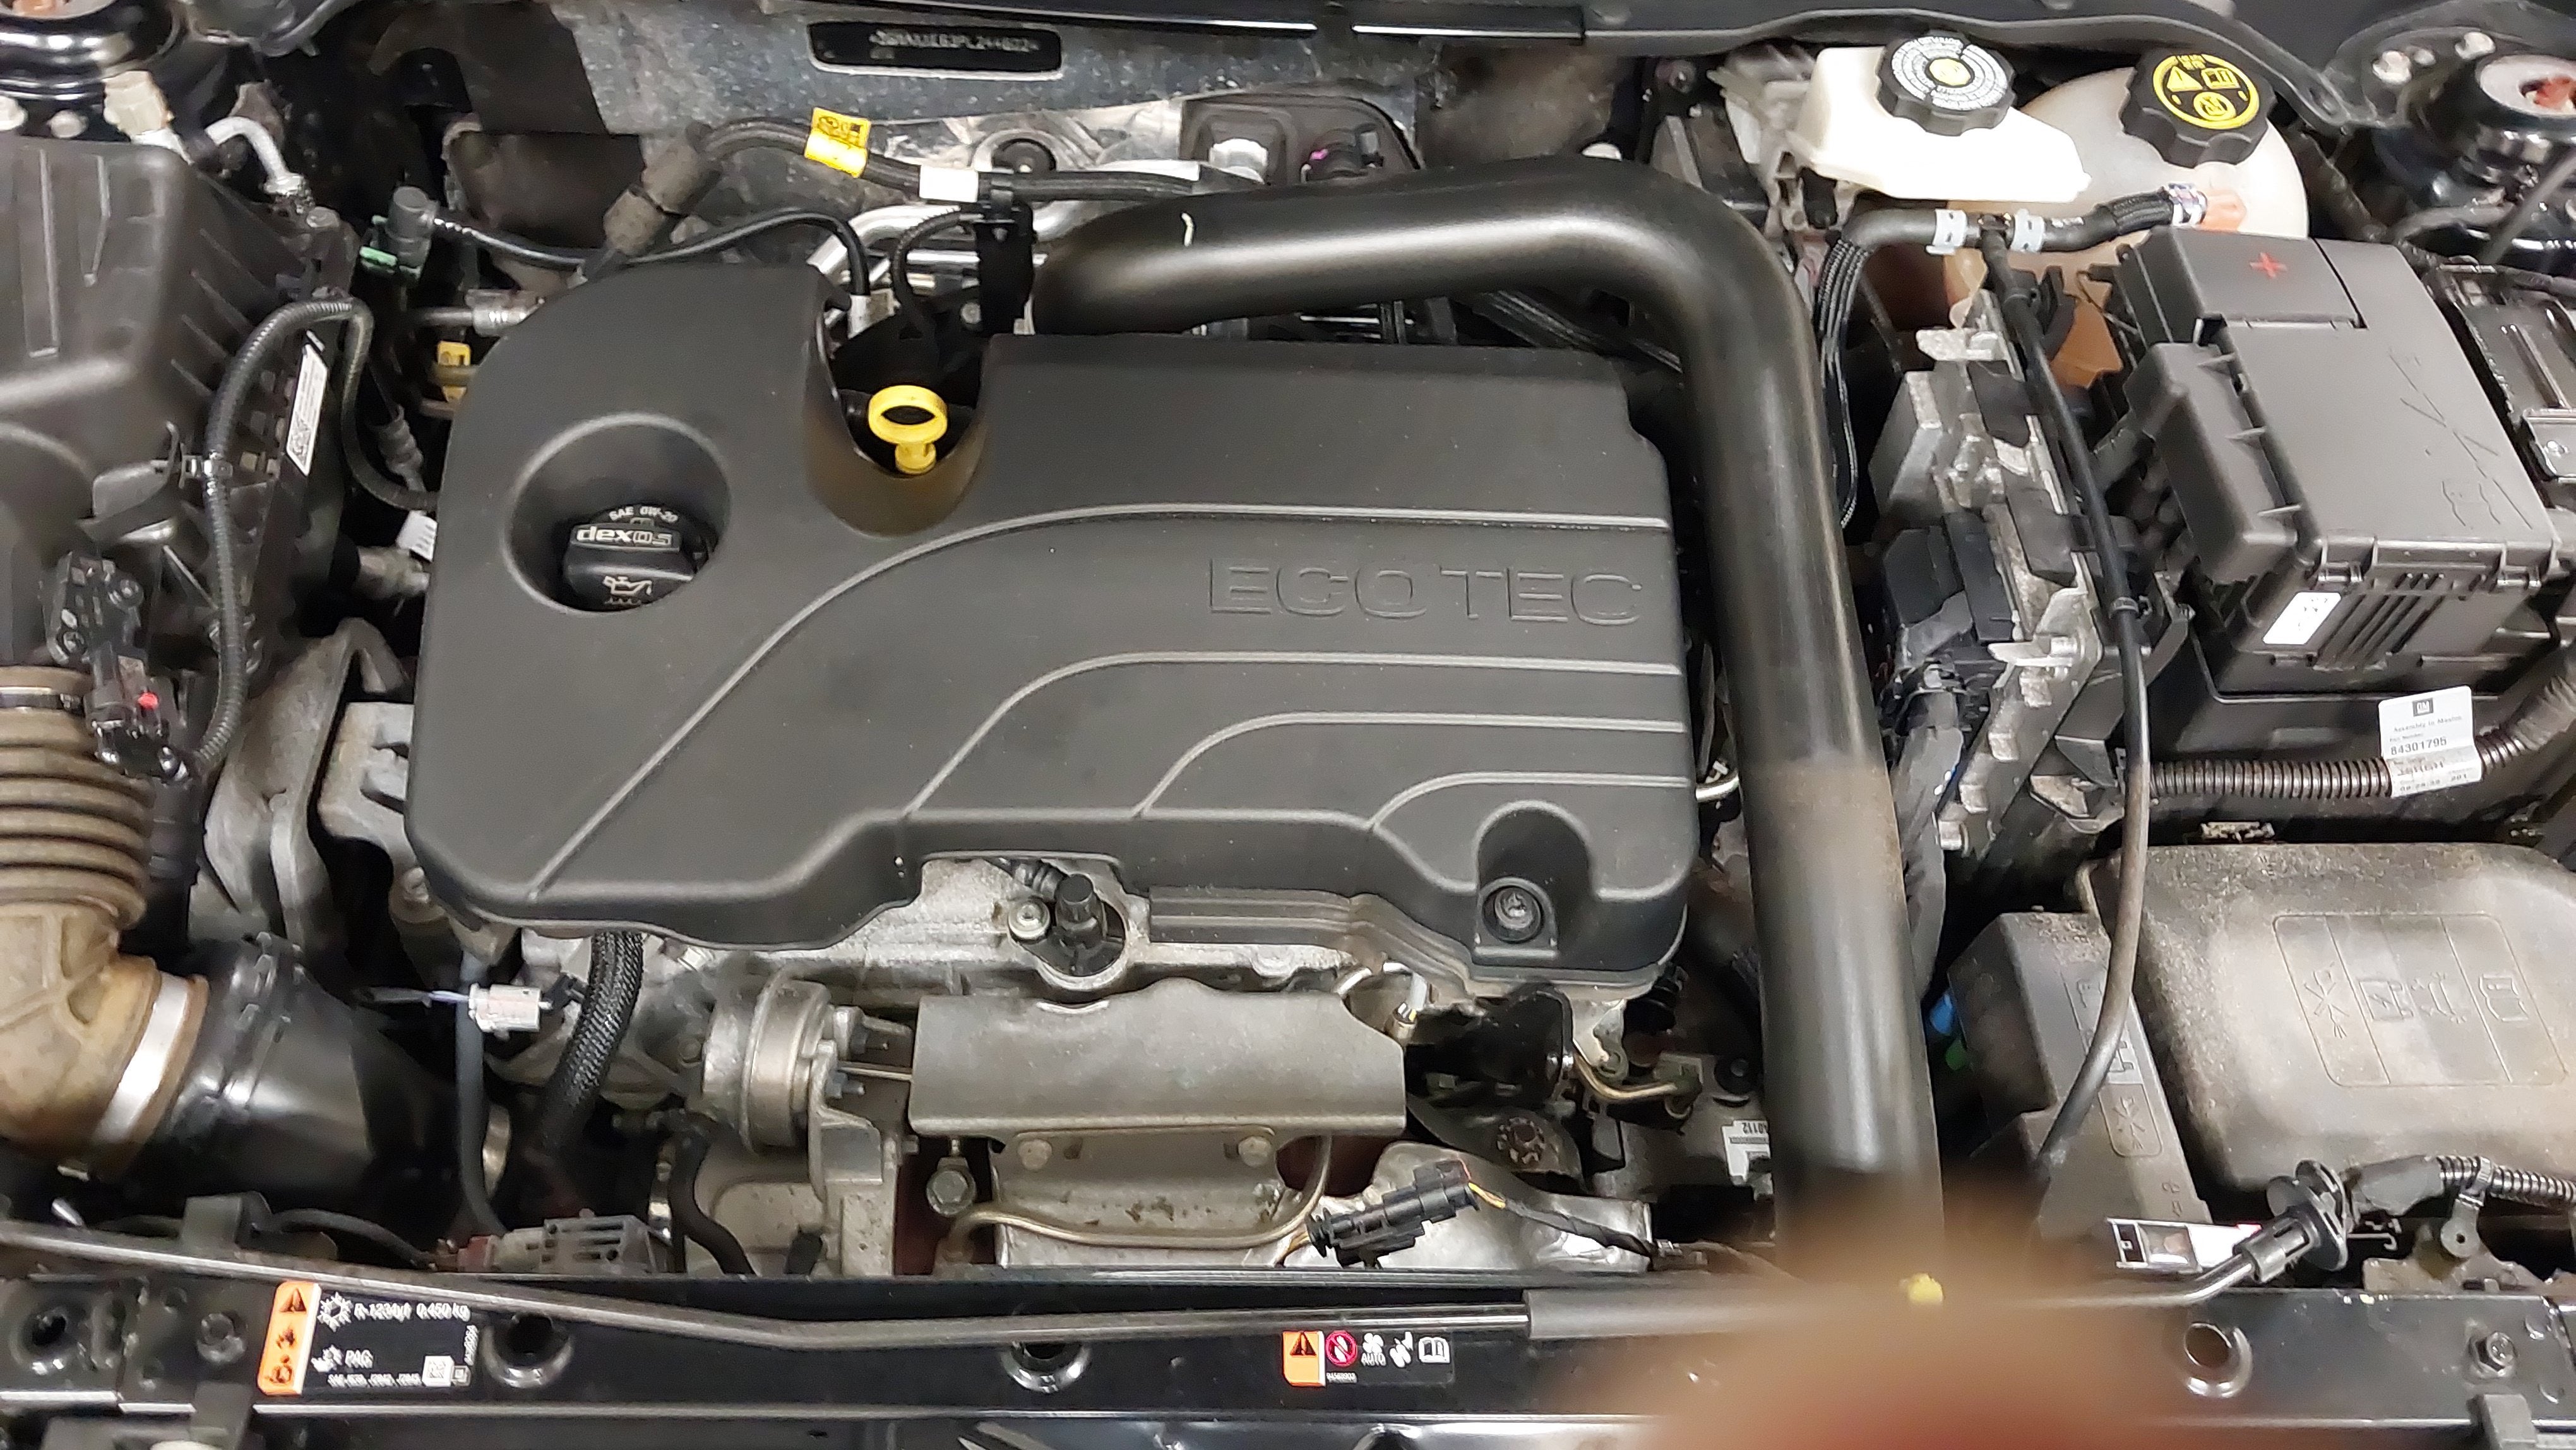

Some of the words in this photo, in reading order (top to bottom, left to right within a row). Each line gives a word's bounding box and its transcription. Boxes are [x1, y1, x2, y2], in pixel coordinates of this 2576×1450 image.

[609, 506, 635, 521] SAE
[640, 506, 679, 523] 0W-20
[576, 525, 672, 546] dexos
[1208, 558, 1643, 626] ECOTEC
[344, 1349, 374, 1369] PAG
[1361, 1352, 1386, 1367] AUTO
